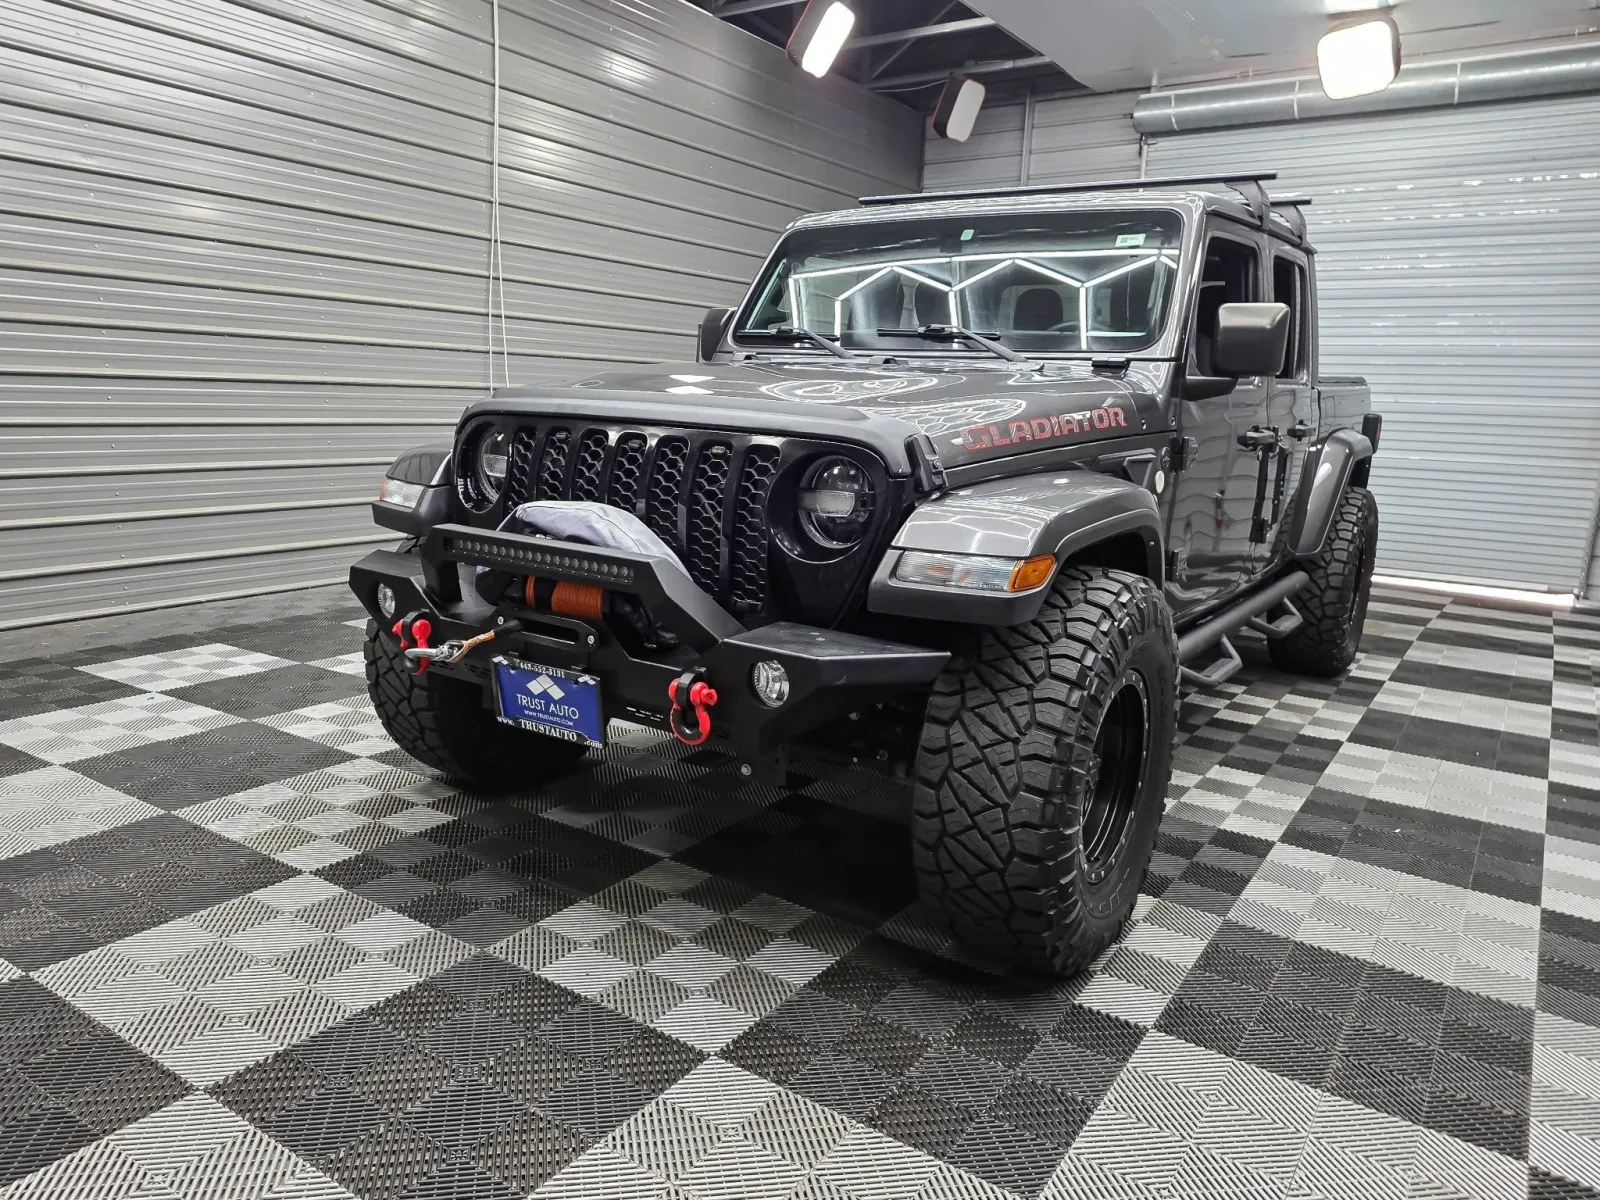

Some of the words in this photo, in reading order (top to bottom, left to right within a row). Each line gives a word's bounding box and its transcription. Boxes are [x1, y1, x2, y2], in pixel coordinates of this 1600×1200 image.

[959, 406, 1128, 451] GLADIATOR
[516, 693, 545, 711] TRUST
[548, 702, 579, 719] AUTO
[520, 718, 577, 742] TRUSTAUTO
